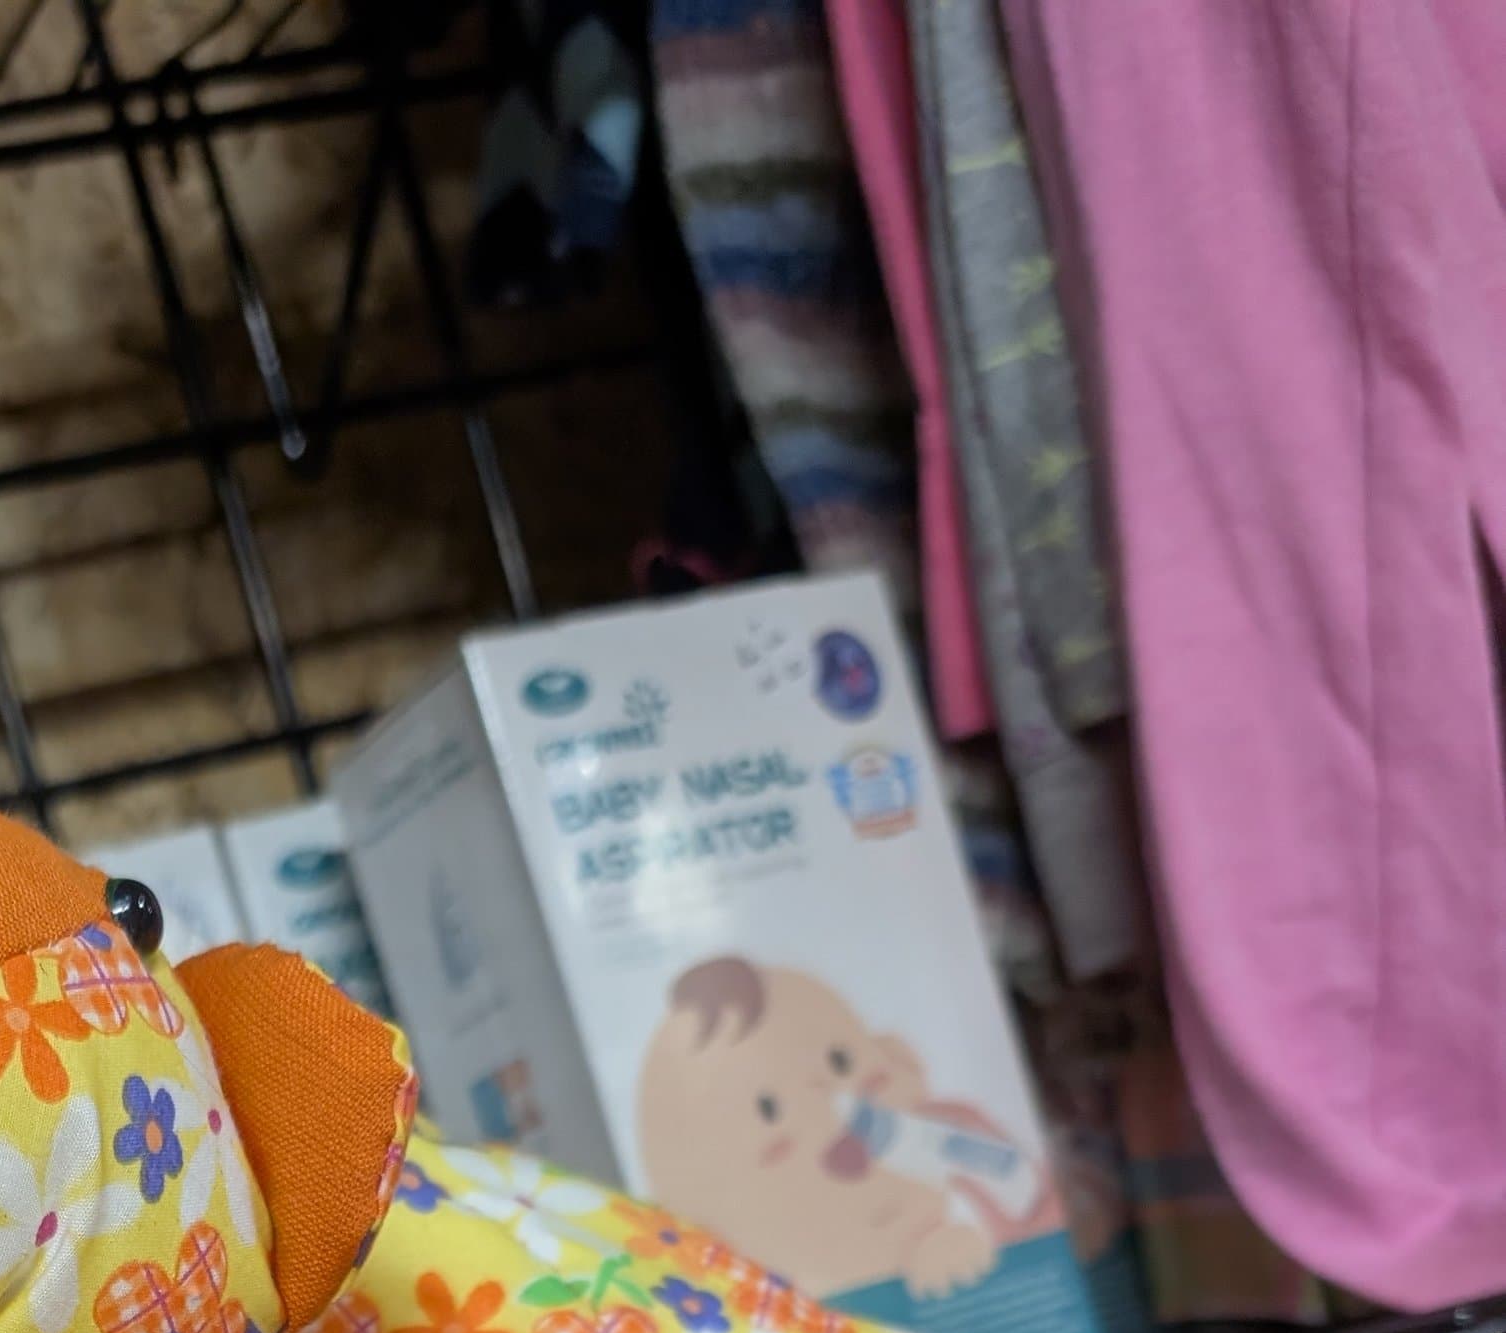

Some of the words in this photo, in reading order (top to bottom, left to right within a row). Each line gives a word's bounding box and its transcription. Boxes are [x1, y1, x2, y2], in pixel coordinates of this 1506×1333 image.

[550, 776, 661, 834] BABY
[680, 749, 808, 804] NASAL
[576, 807, 796, 883] ASRATOR
